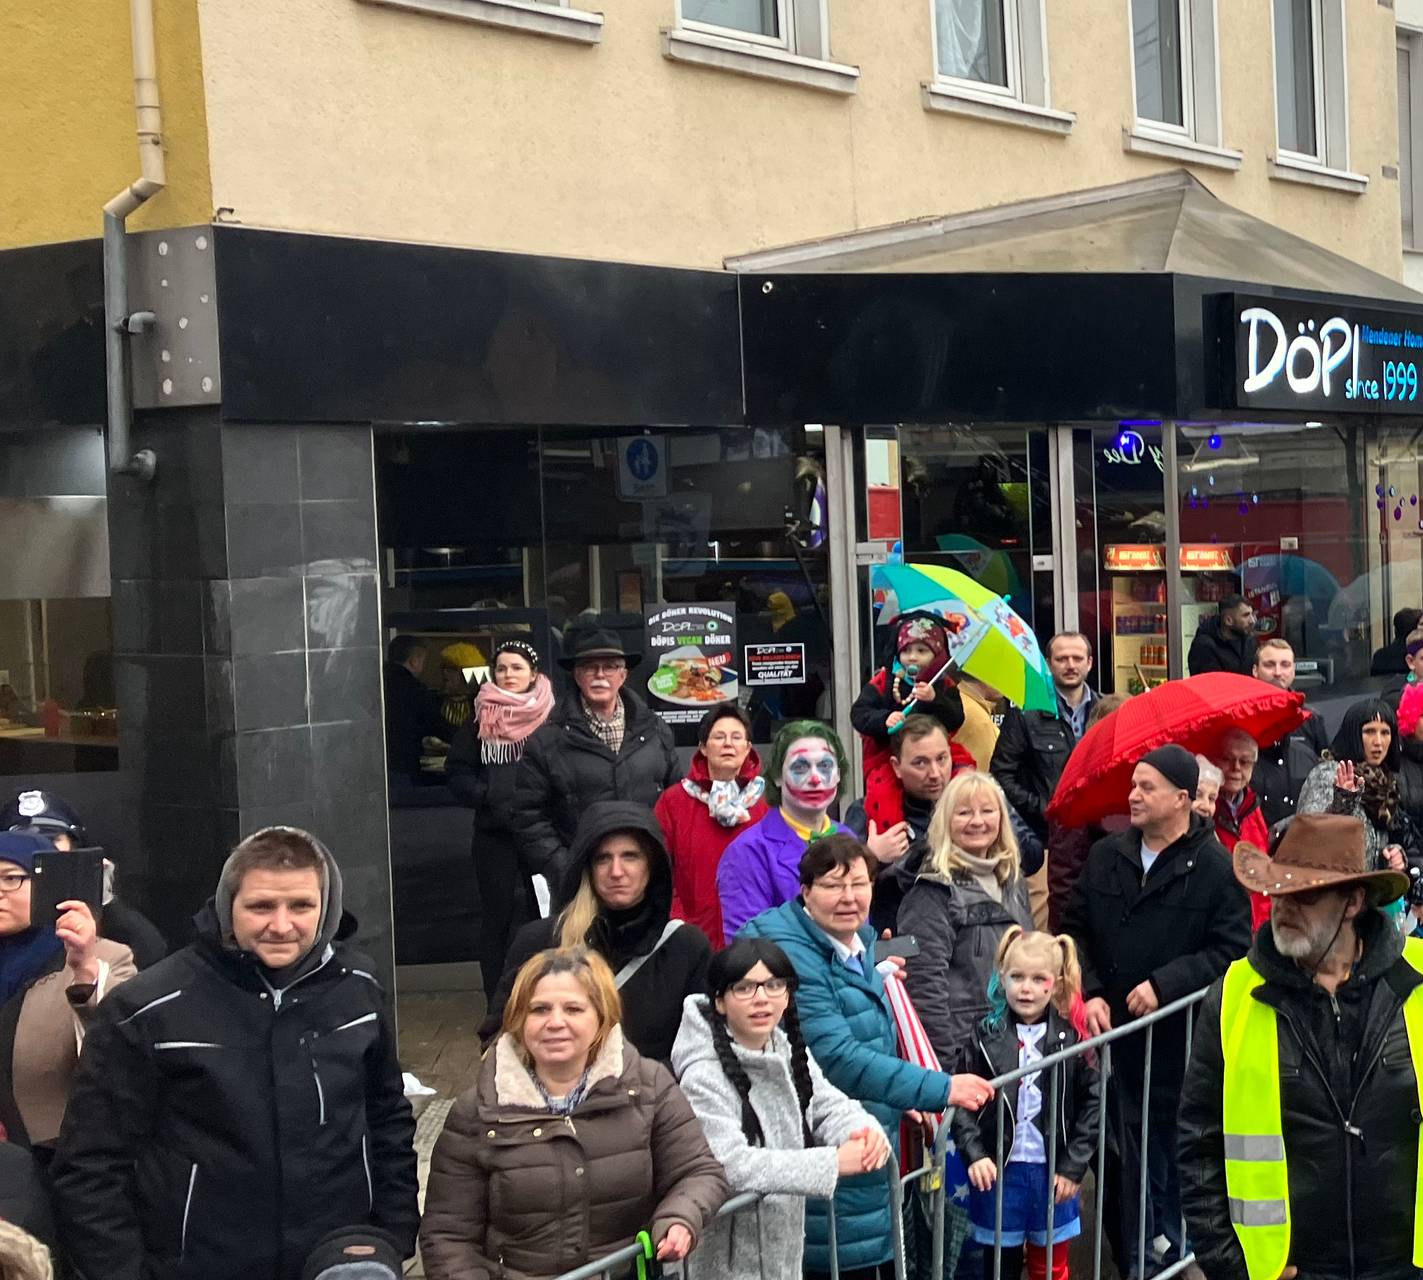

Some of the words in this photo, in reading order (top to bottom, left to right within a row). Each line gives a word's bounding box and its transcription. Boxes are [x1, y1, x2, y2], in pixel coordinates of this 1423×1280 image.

[1240, 307, 1360, 399] DÖPI
[1382, 360, 1418, 401] 1999
[661, 607, 687, 619] DÖNER
[688, 606, 733, 624] REVOLUTION
[651, 634, 675, 647] DÖPIS
[676, 635, 703, 645] VEGAN
[704, 633, 731, 645] DÖNER
[708, 654, 727, 666] NEU
[757, 668, 793, 679] QUALITÄT
